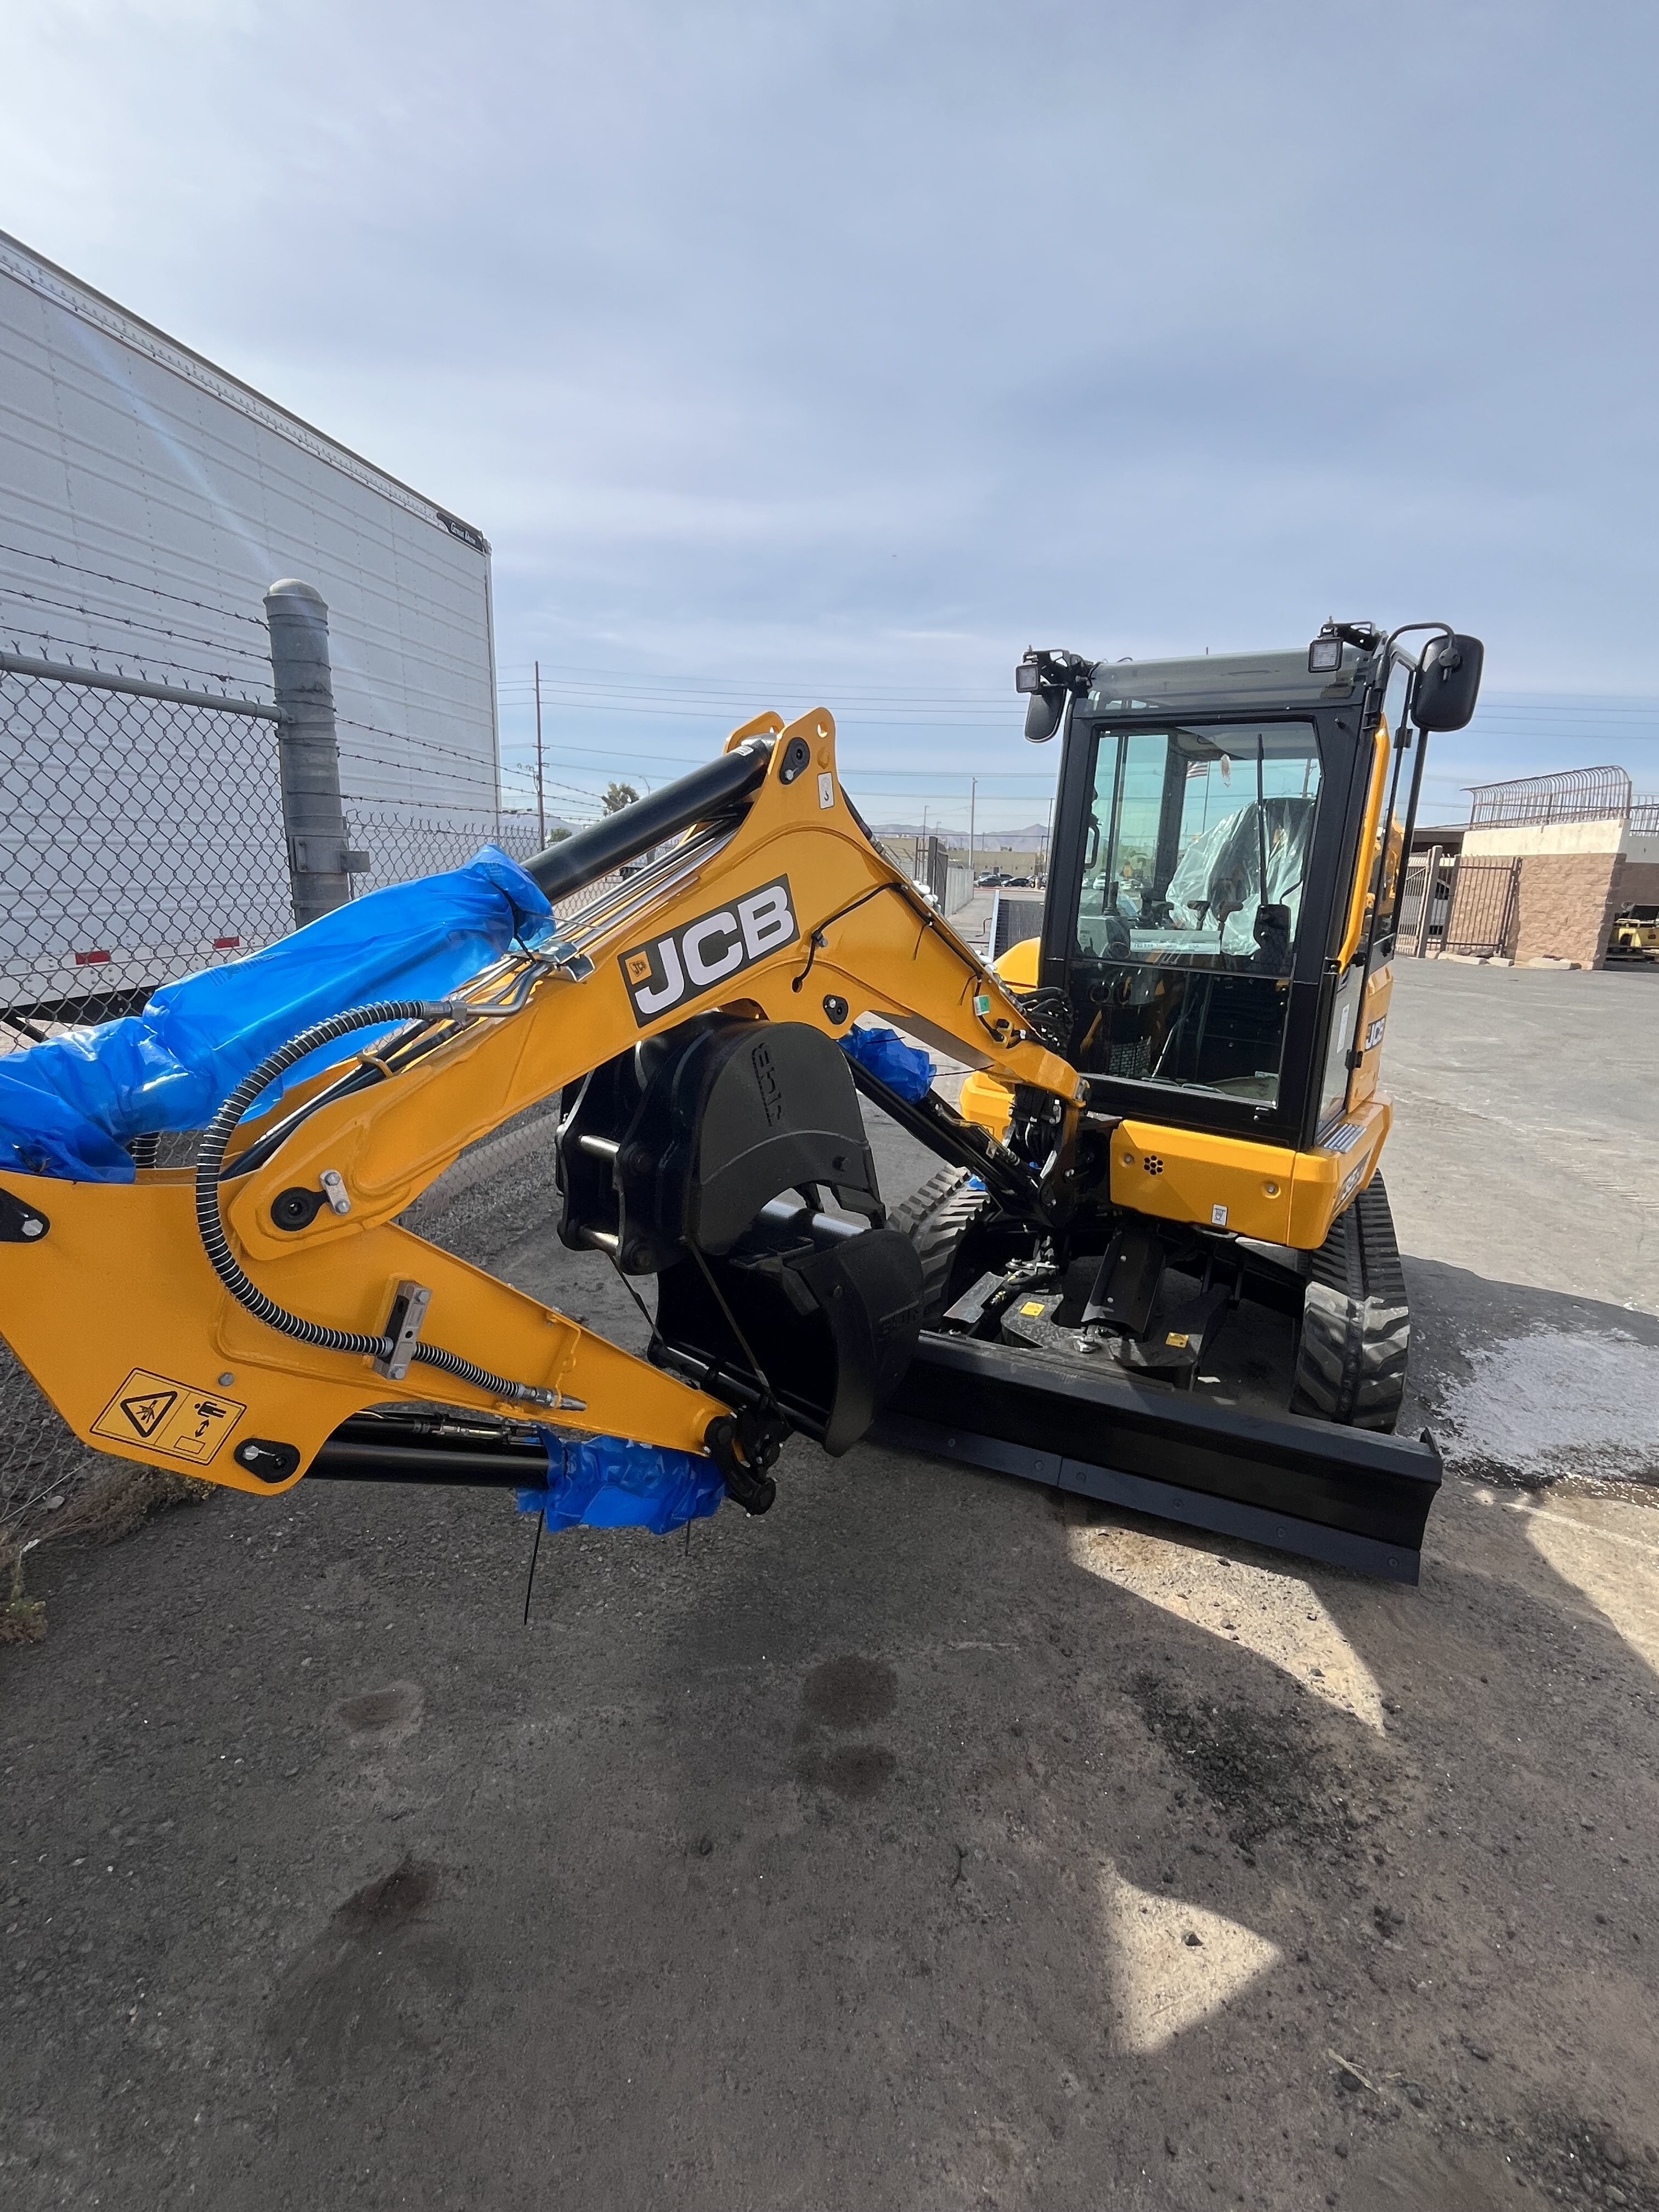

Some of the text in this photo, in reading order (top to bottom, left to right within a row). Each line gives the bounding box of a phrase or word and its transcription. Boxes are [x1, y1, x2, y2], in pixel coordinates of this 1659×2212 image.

[635, 886, 794, 1014] JCB
[632, 961, 646, 974] JCB
[1365, 1018, 1385, 1049] JCB
